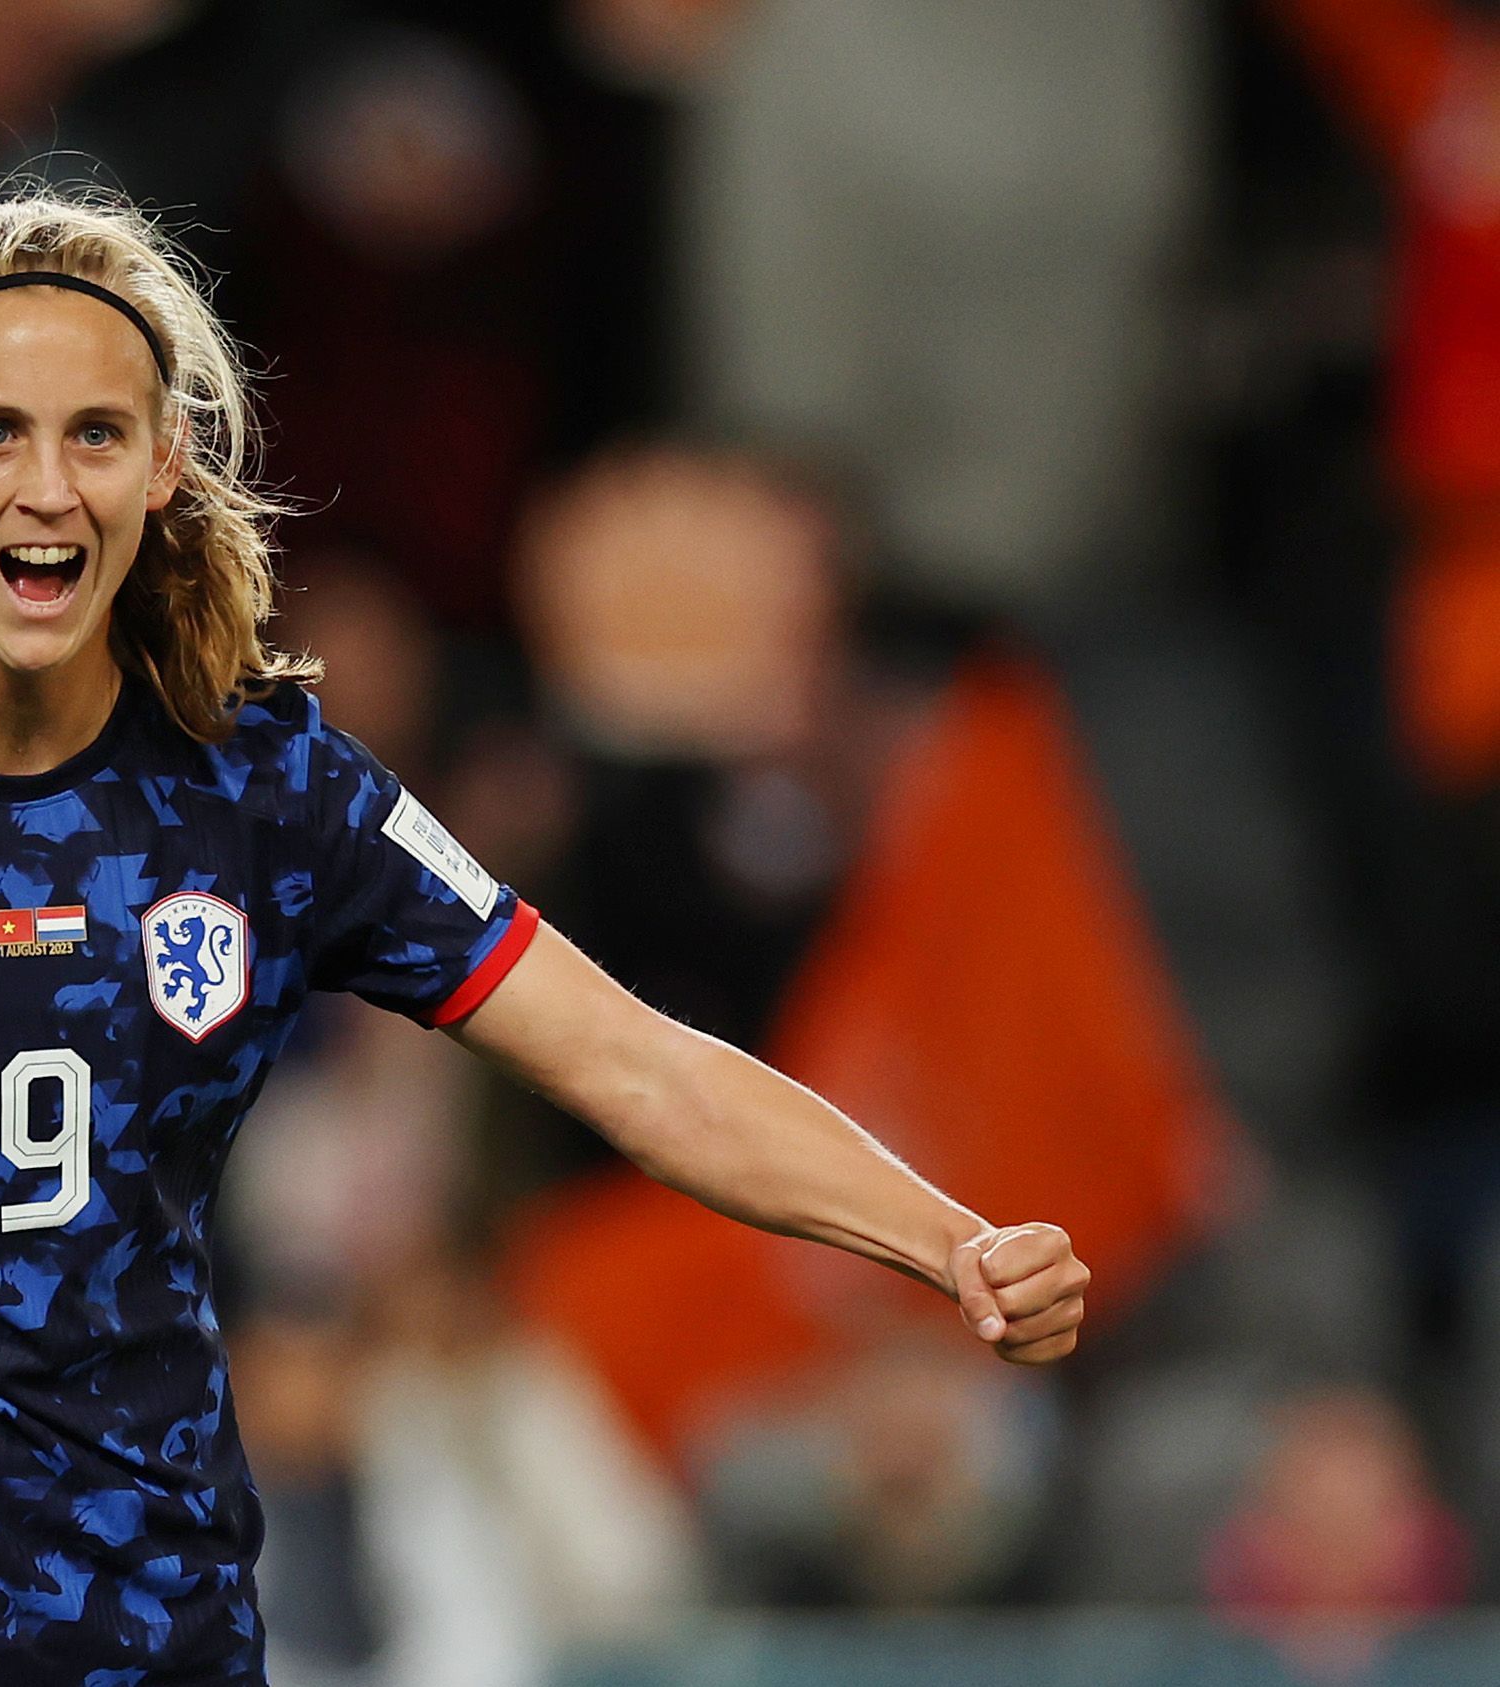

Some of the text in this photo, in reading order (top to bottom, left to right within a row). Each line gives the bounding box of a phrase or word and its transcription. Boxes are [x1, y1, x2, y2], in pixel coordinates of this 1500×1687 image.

[0, 942, 74, 958] 1 AUGUST 2023
[1, 1047, 91, 1233] 9
